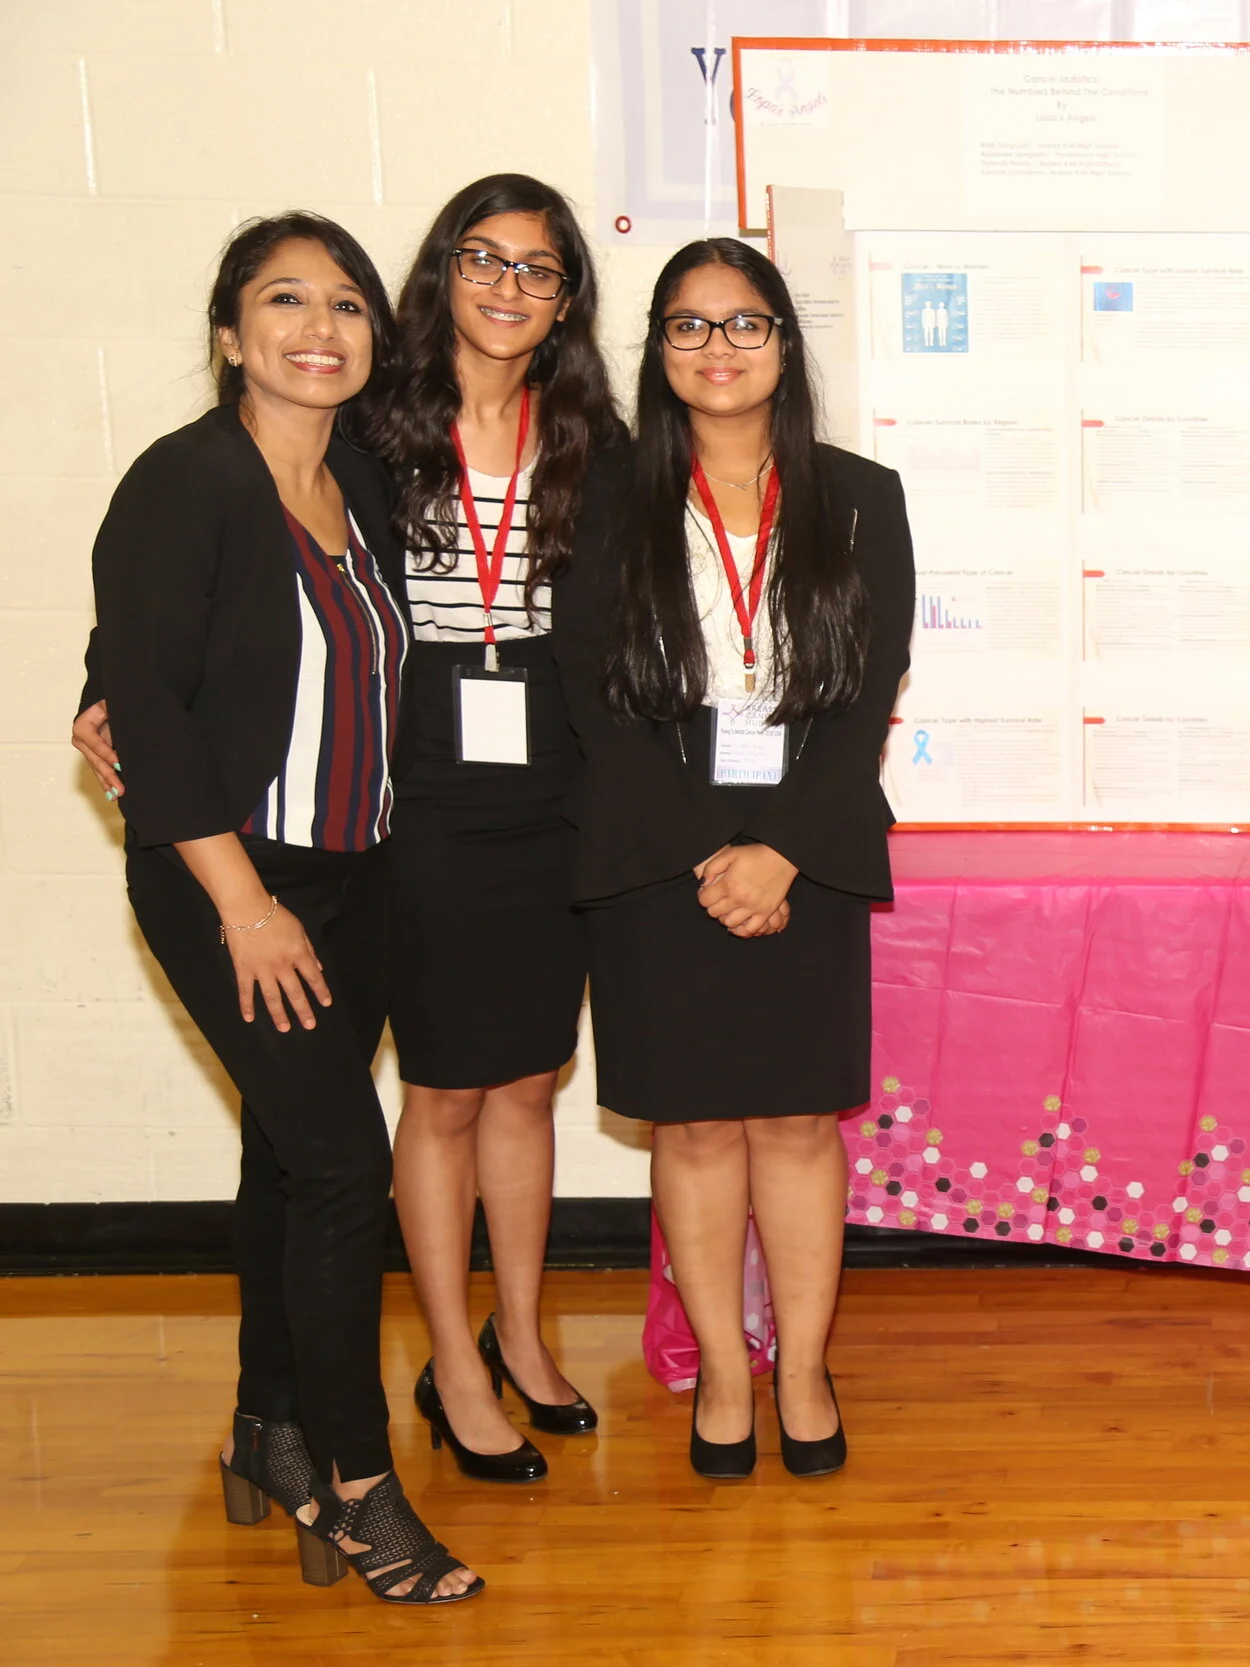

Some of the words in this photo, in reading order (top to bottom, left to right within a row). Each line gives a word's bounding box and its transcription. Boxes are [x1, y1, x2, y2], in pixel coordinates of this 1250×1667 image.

[1023, 75, 1056, 83] Cancer
[990, 87, 1006, 96] The
[1008, 87, 1048, 96] Numbers
[1050, 87, 1081, 96] Behind
[1083, 87, 1099, 96] The
[1056, 100, 1067, 110] By
[1115, 415, 1141, 423] Cancer
[720, 768, 777, 780] PARTICIPANT
